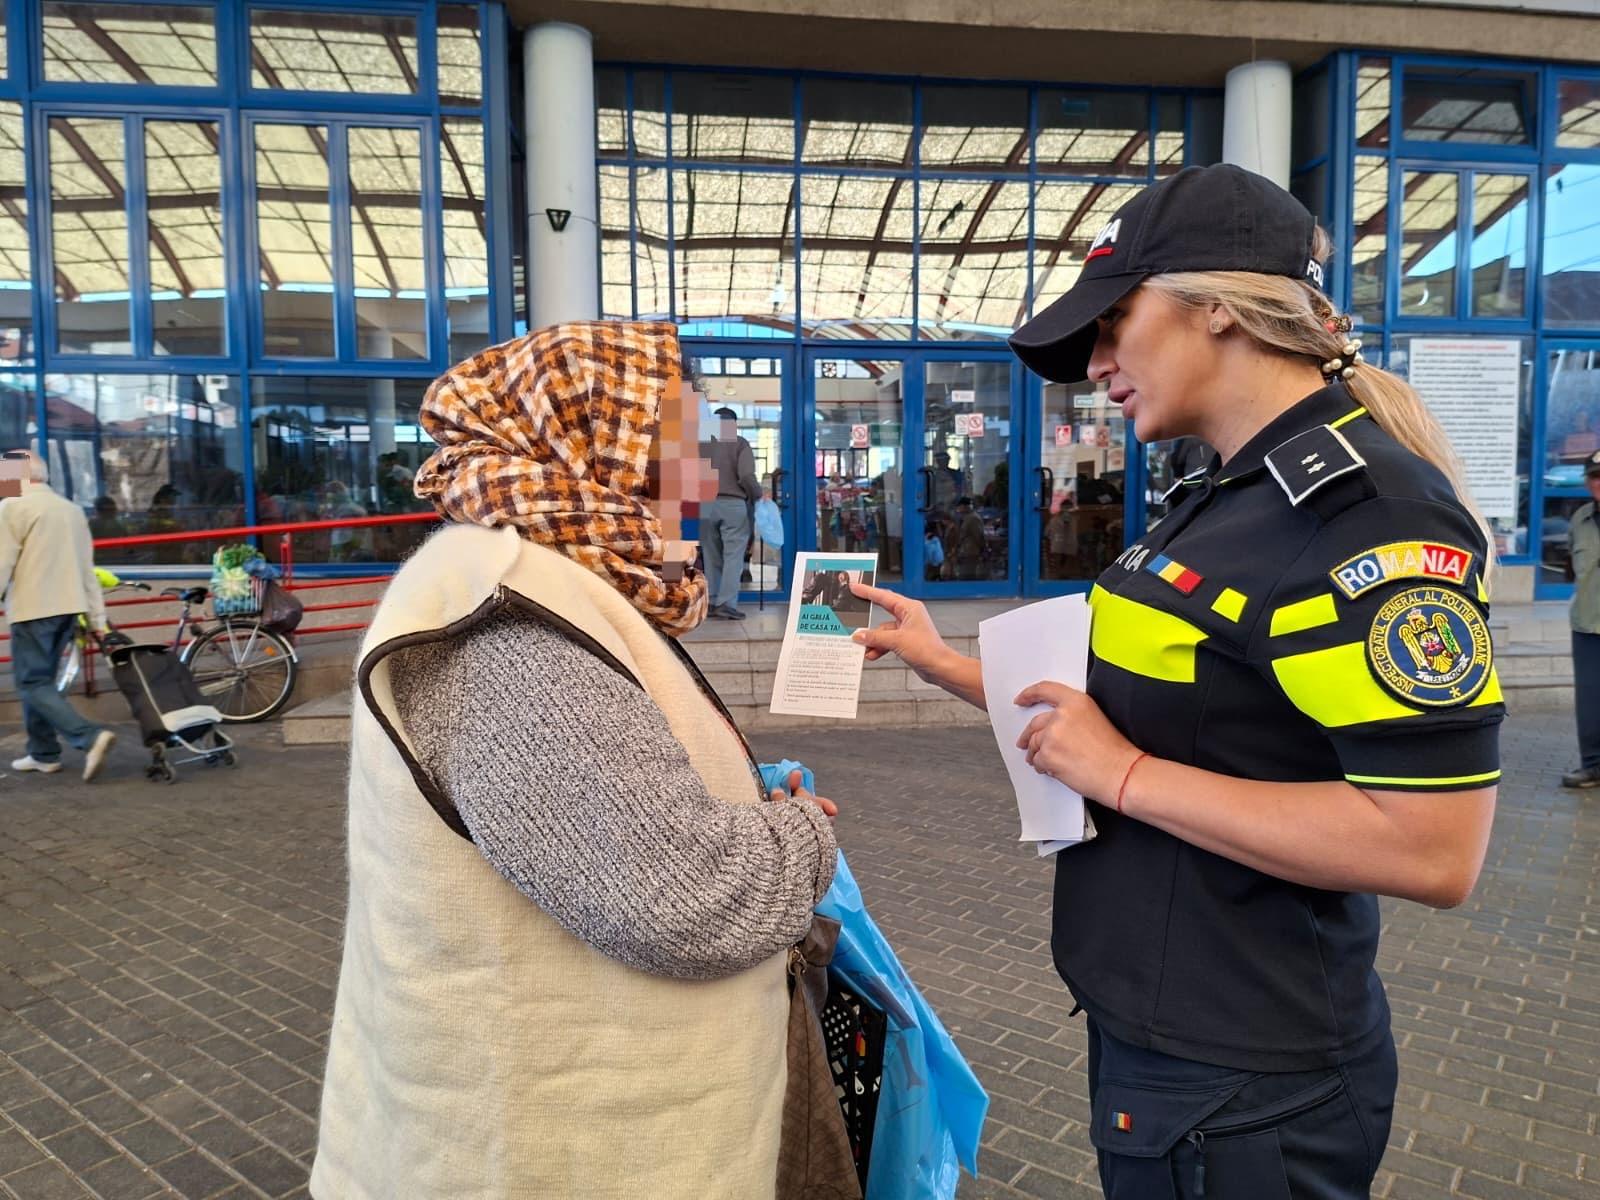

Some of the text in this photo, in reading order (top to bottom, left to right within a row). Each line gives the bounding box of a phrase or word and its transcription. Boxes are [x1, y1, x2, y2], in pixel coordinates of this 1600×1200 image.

[1337, 548, 1460, 592] ROMANIA
[1381, 593, 1421, 621] GENERAL
[1424, 591, 1438, 601] AL
[810, 623, 829, 631] CASA
[1374, 624, 1415, 693] INSPECTORATUL
